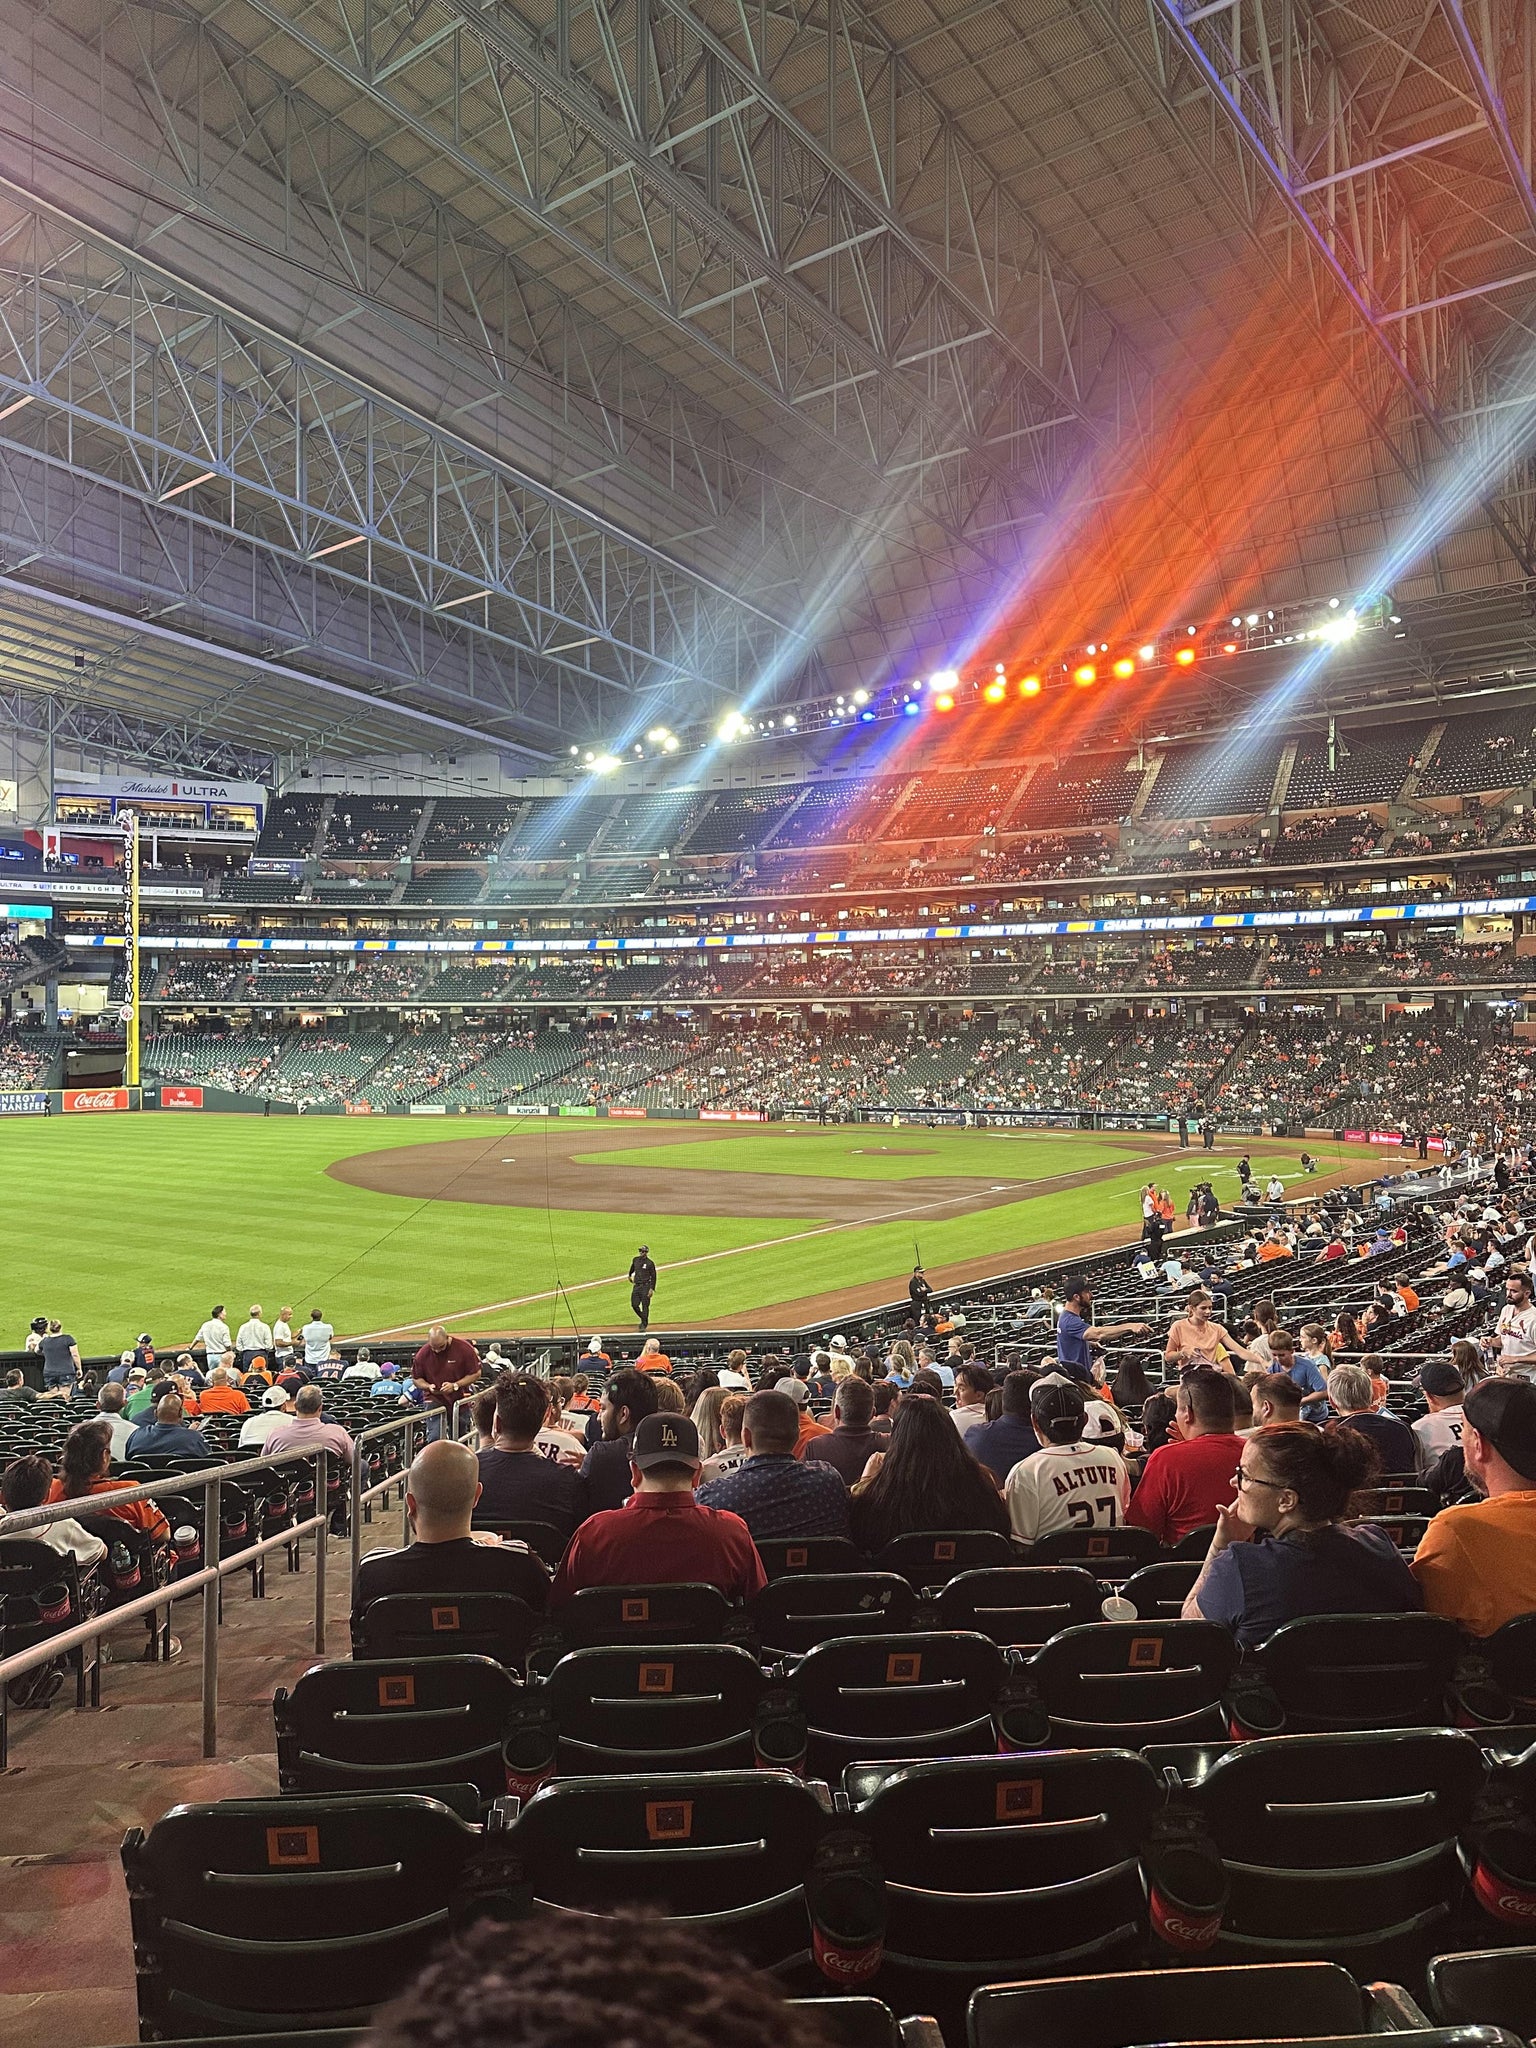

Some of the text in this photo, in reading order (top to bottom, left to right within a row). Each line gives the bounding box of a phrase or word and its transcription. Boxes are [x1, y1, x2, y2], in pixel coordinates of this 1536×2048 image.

[121, 782, 228, 797] Michelob ULTRA
[123, 837, 133, 880] ROOT
[123, 901, 133, 934] THA
[123, 938, 134, 1003] CHIKIN
[0, 1095, 36, 1103] NERGY
[0, 1102, 46, 1111] RANSFER
[661, 1424, 678, 1447] LA
[1052, 1466, 1117, 1497] ALTUVE
[1067, 1495, 1117, 1528] 27
